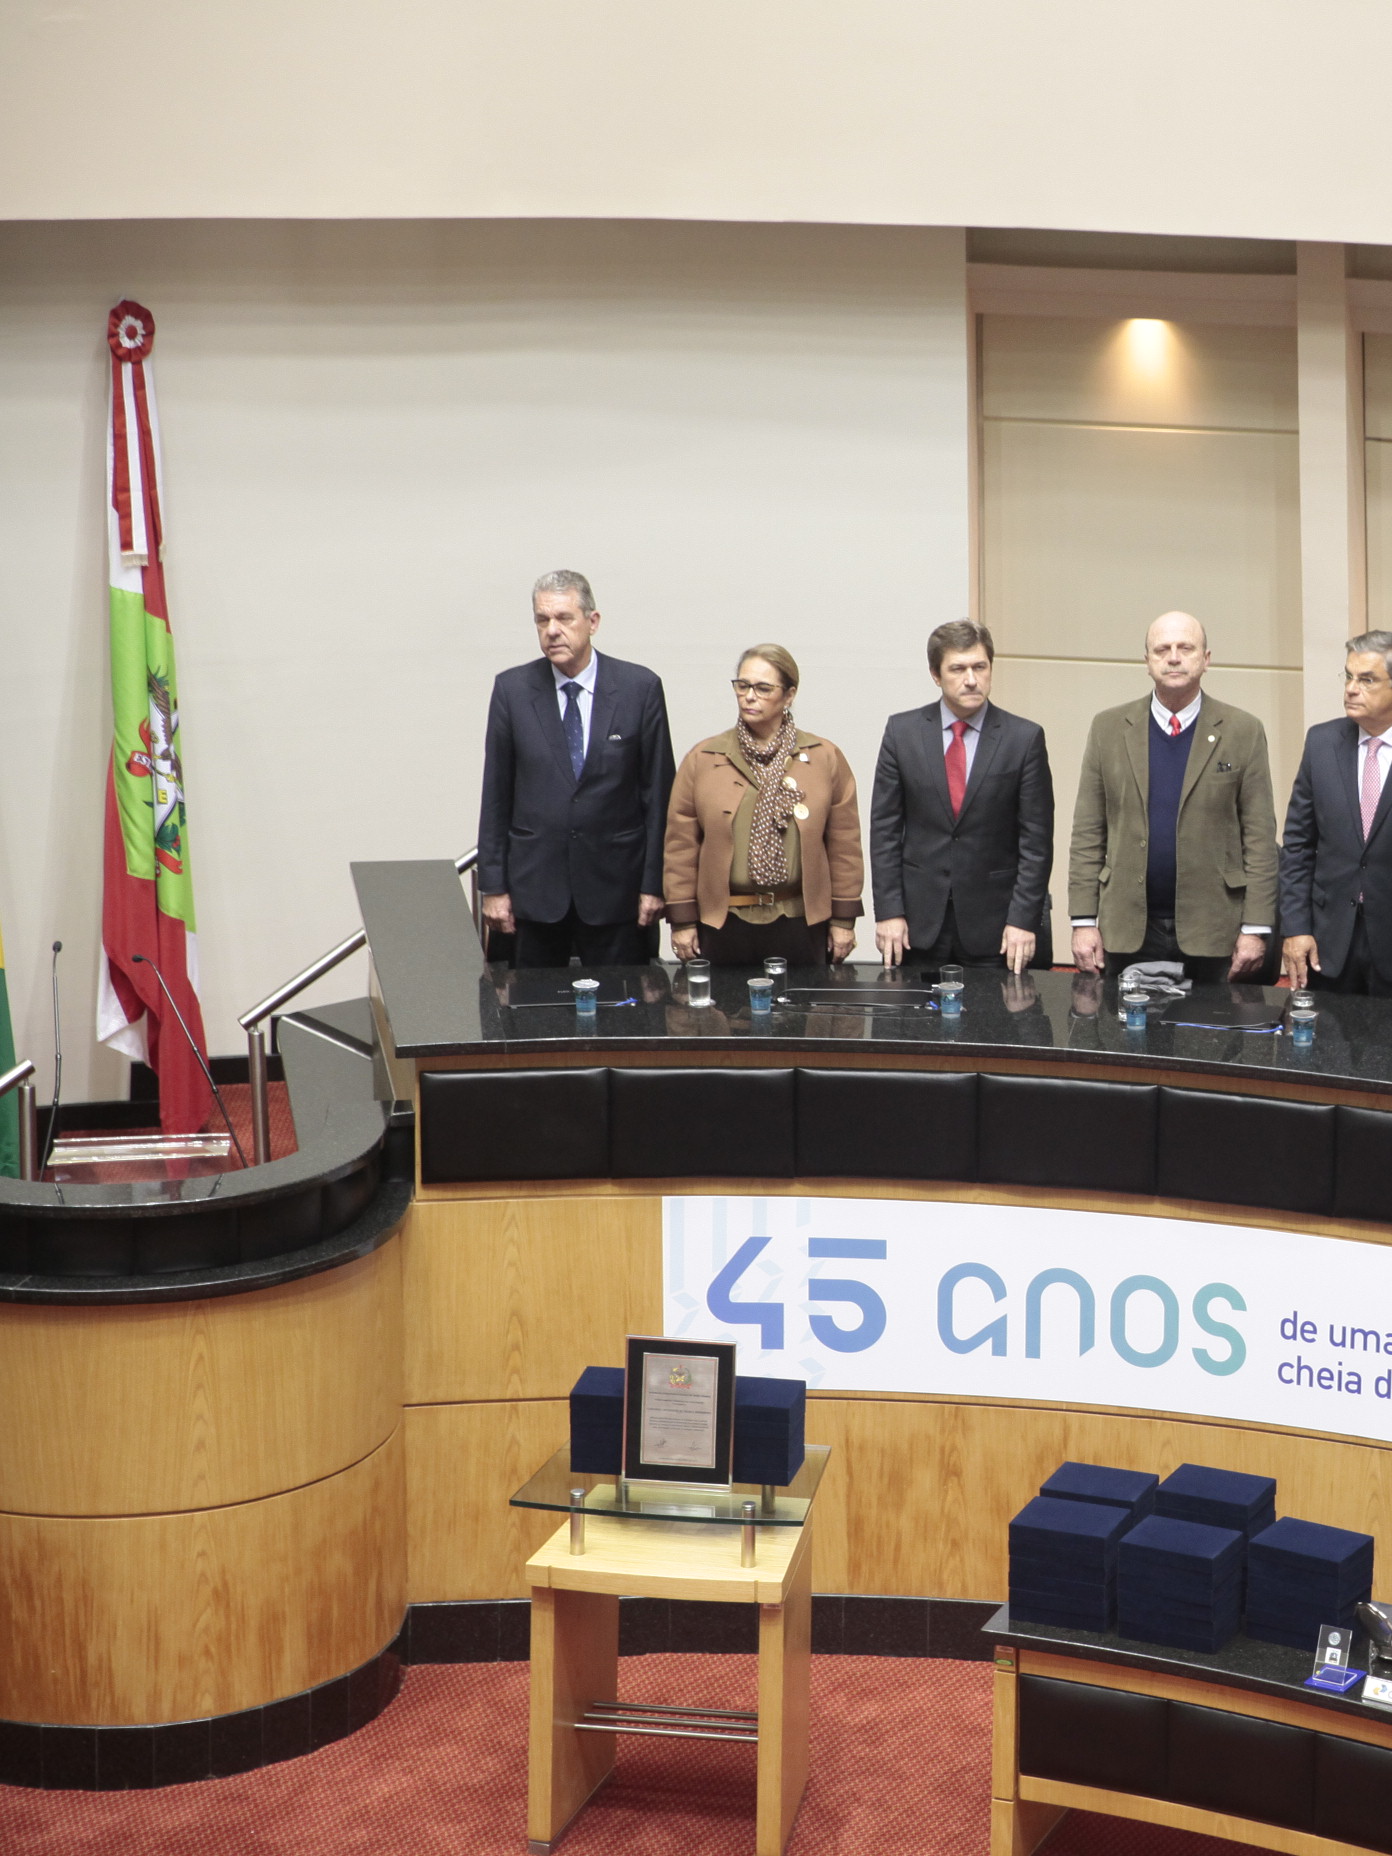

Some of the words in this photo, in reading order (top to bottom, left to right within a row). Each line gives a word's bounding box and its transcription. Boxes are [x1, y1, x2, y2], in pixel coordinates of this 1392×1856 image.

[707, 1236, 887, 1353] 45
[937, 1262, 1248, 1377] anos
[1279, 1310, 1317, 1344] de
[1277, 1355, 1362, 1395] cheia
